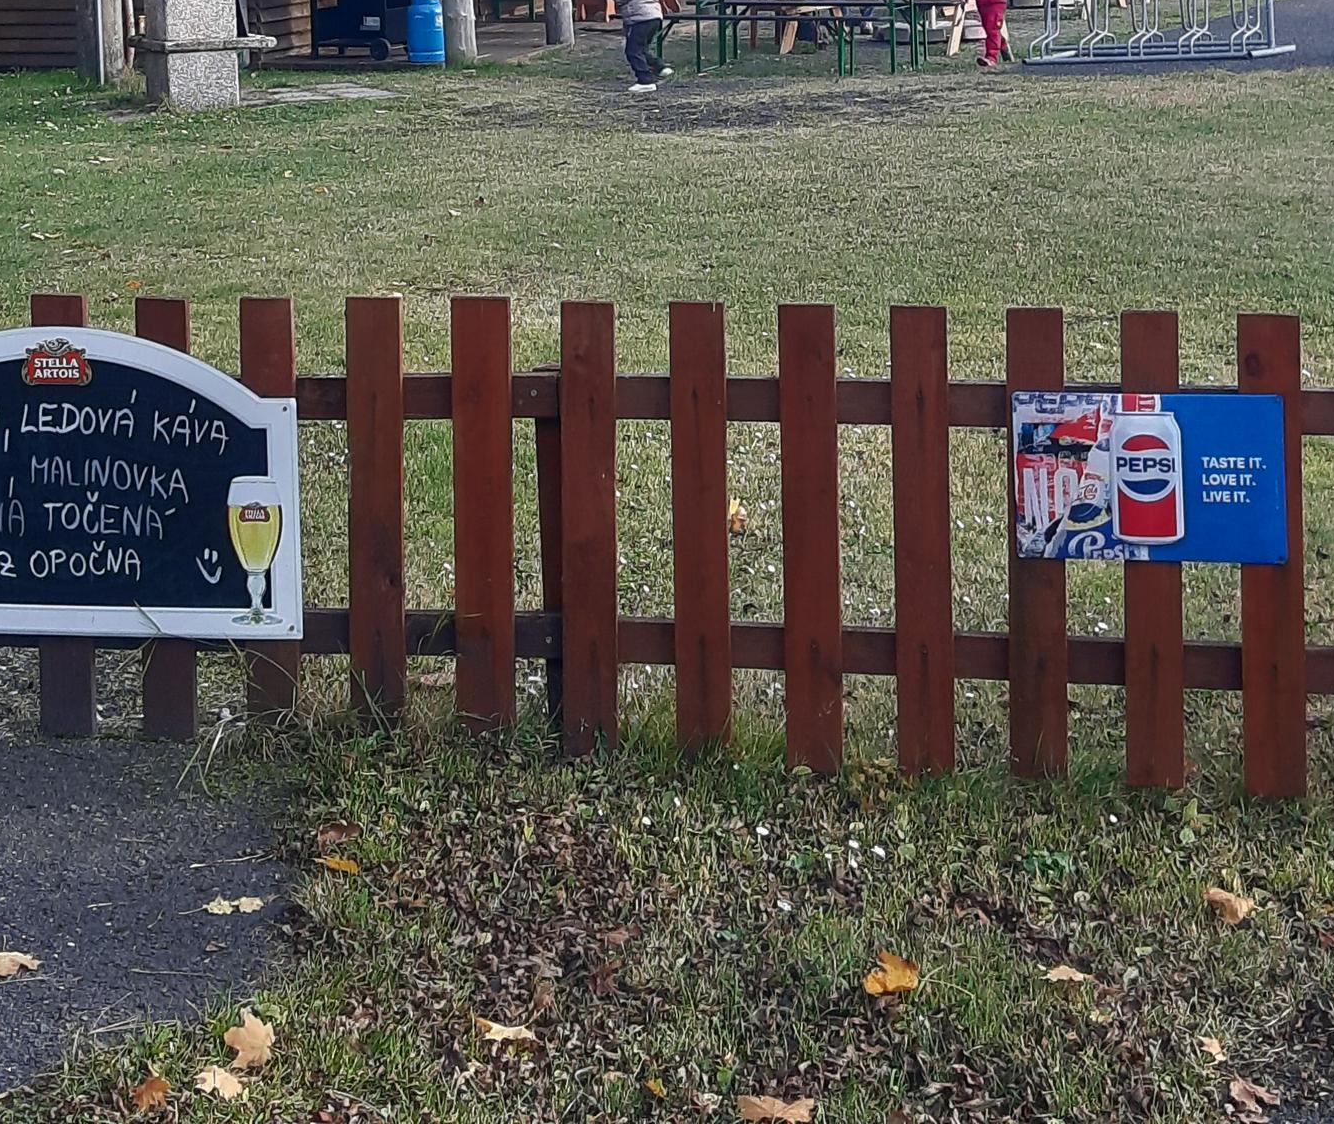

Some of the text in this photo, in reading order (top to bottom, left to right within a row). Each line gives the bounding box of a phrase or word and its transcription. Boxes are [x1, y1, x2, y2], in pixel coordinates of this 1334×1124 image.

[34, 358, 79, 368] STELLA
[34, 368, 80, 379] ARTOIS
[20, 389, 137, 439] LEDOVÁ
[152, 398, 230, 455] KÁVA
[1116, 456, 1177, 473] PEPSI
[1201, 457, 1266, 469] TASTE IT.
[30, 454, 190, 505] MALINOVKA
[1202, 474, 1256, 486] LOVE IT.
[1202, 491, 1250, 503] LIVE IT.
[42, 491, 176, 541] TOČENÁ
[29, 540, 142, 592] OPOČNA
